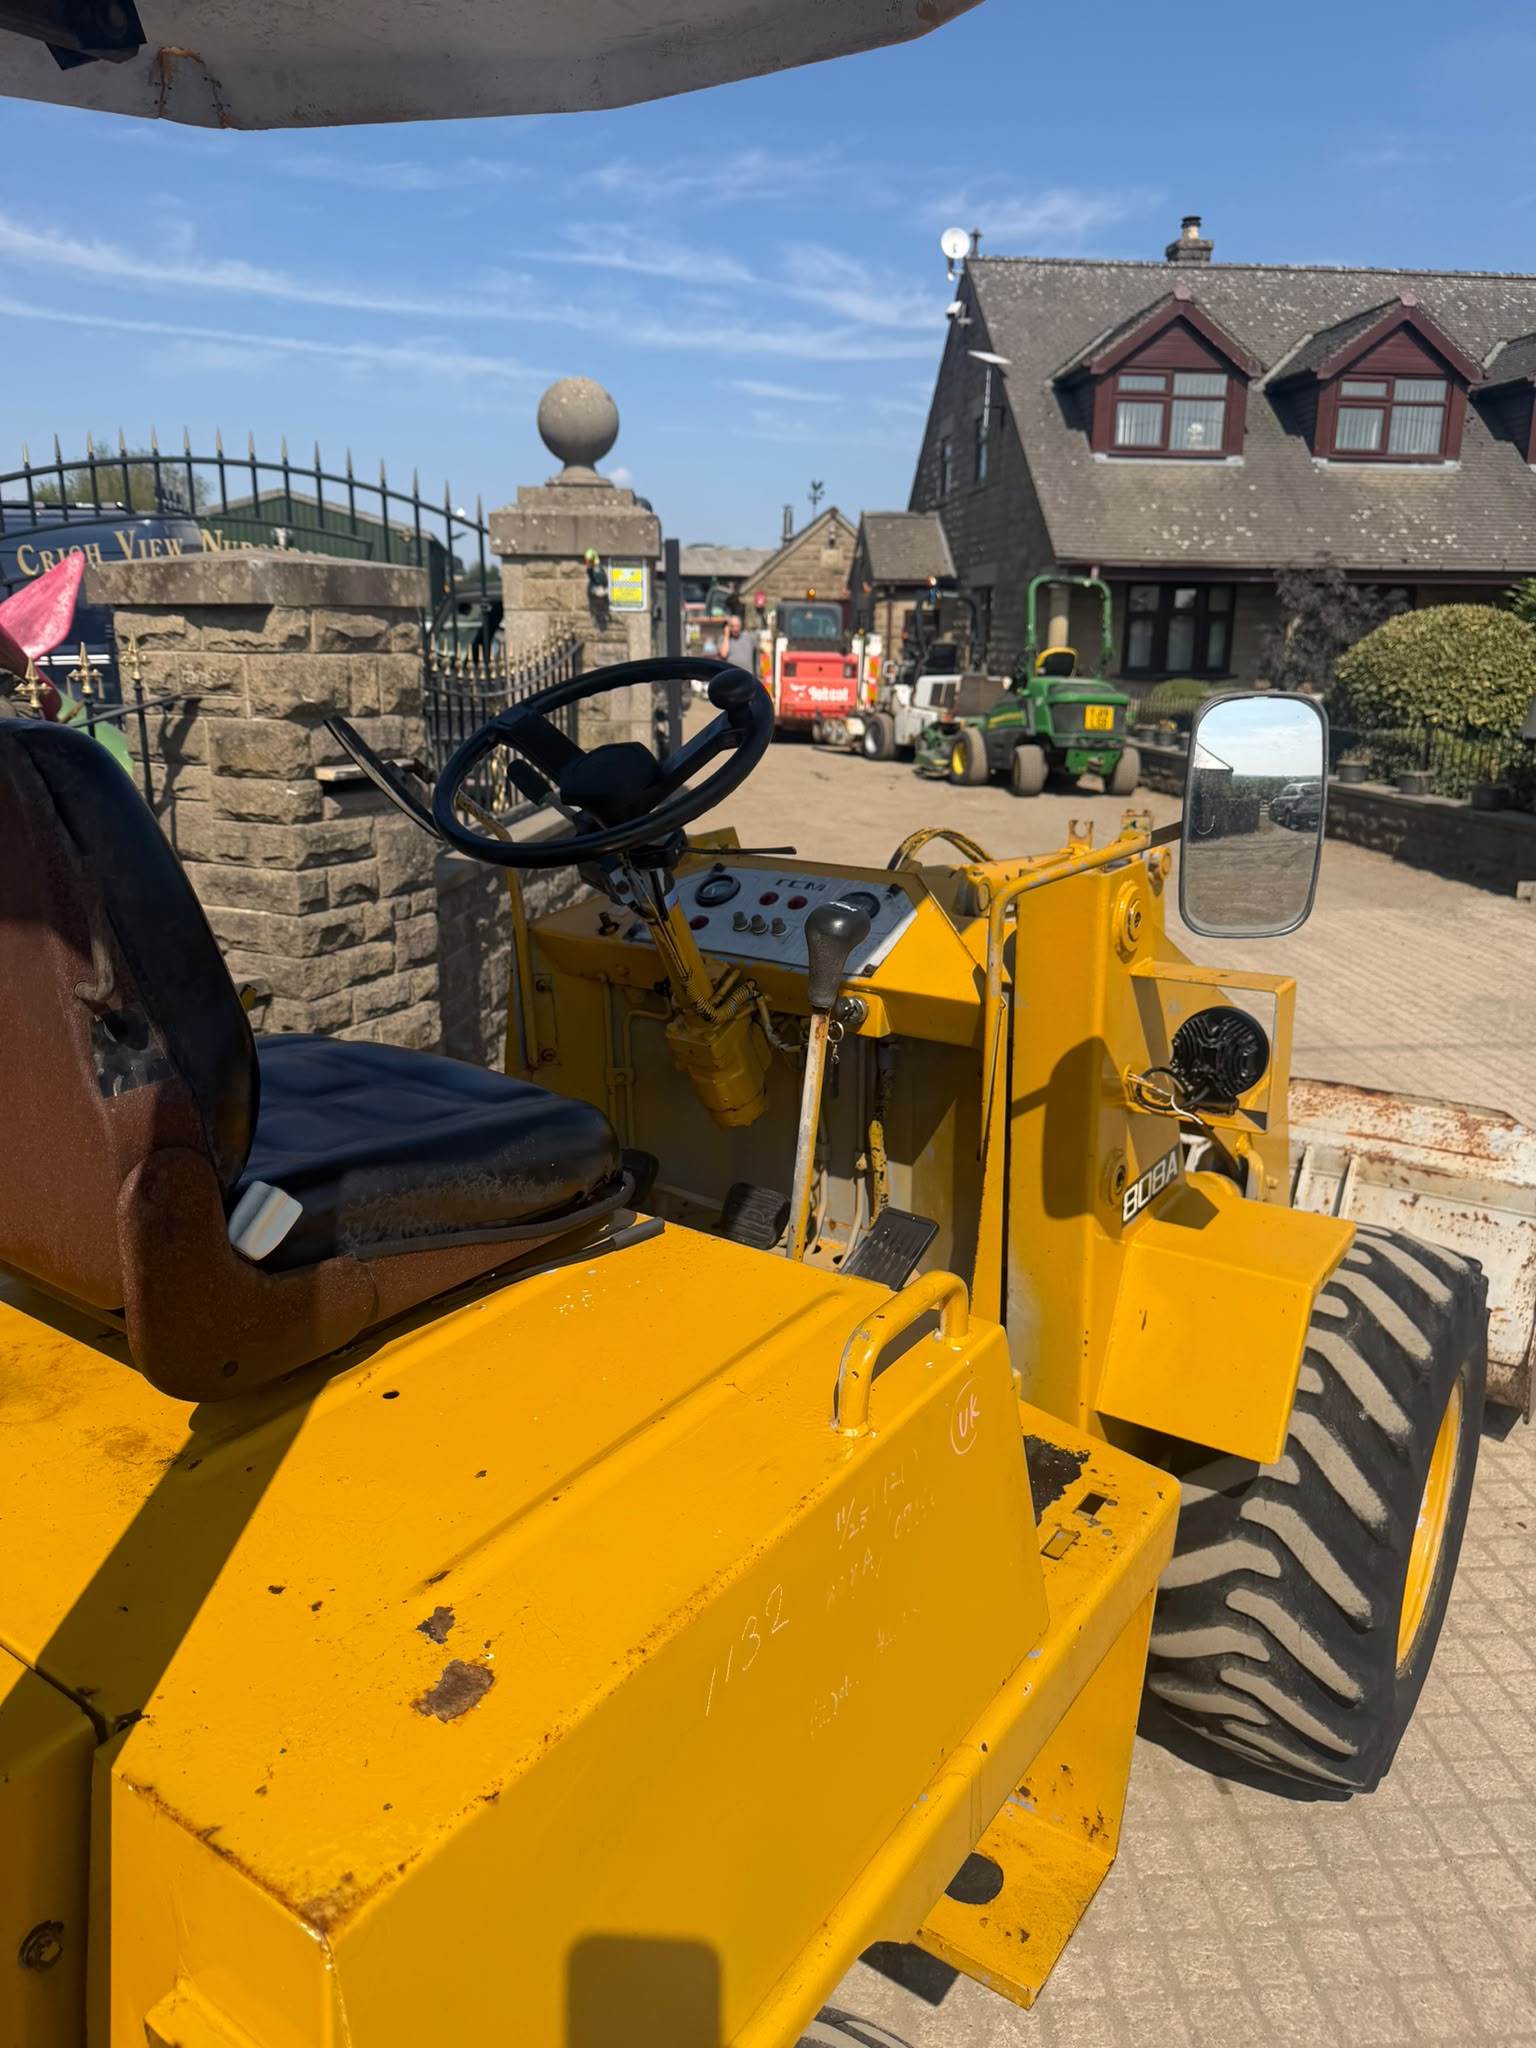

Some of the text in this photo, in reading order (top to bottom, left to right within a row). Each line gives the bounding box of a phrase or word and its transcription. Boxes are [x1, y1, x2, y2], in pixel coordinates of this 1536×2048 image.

[113, 529, 185, 560] VIEW
[1122, 1149, 1178, 1222] 808A
[957, 1393, 980, 1439] UK
[705, 1583, 790, 1717] 1132
